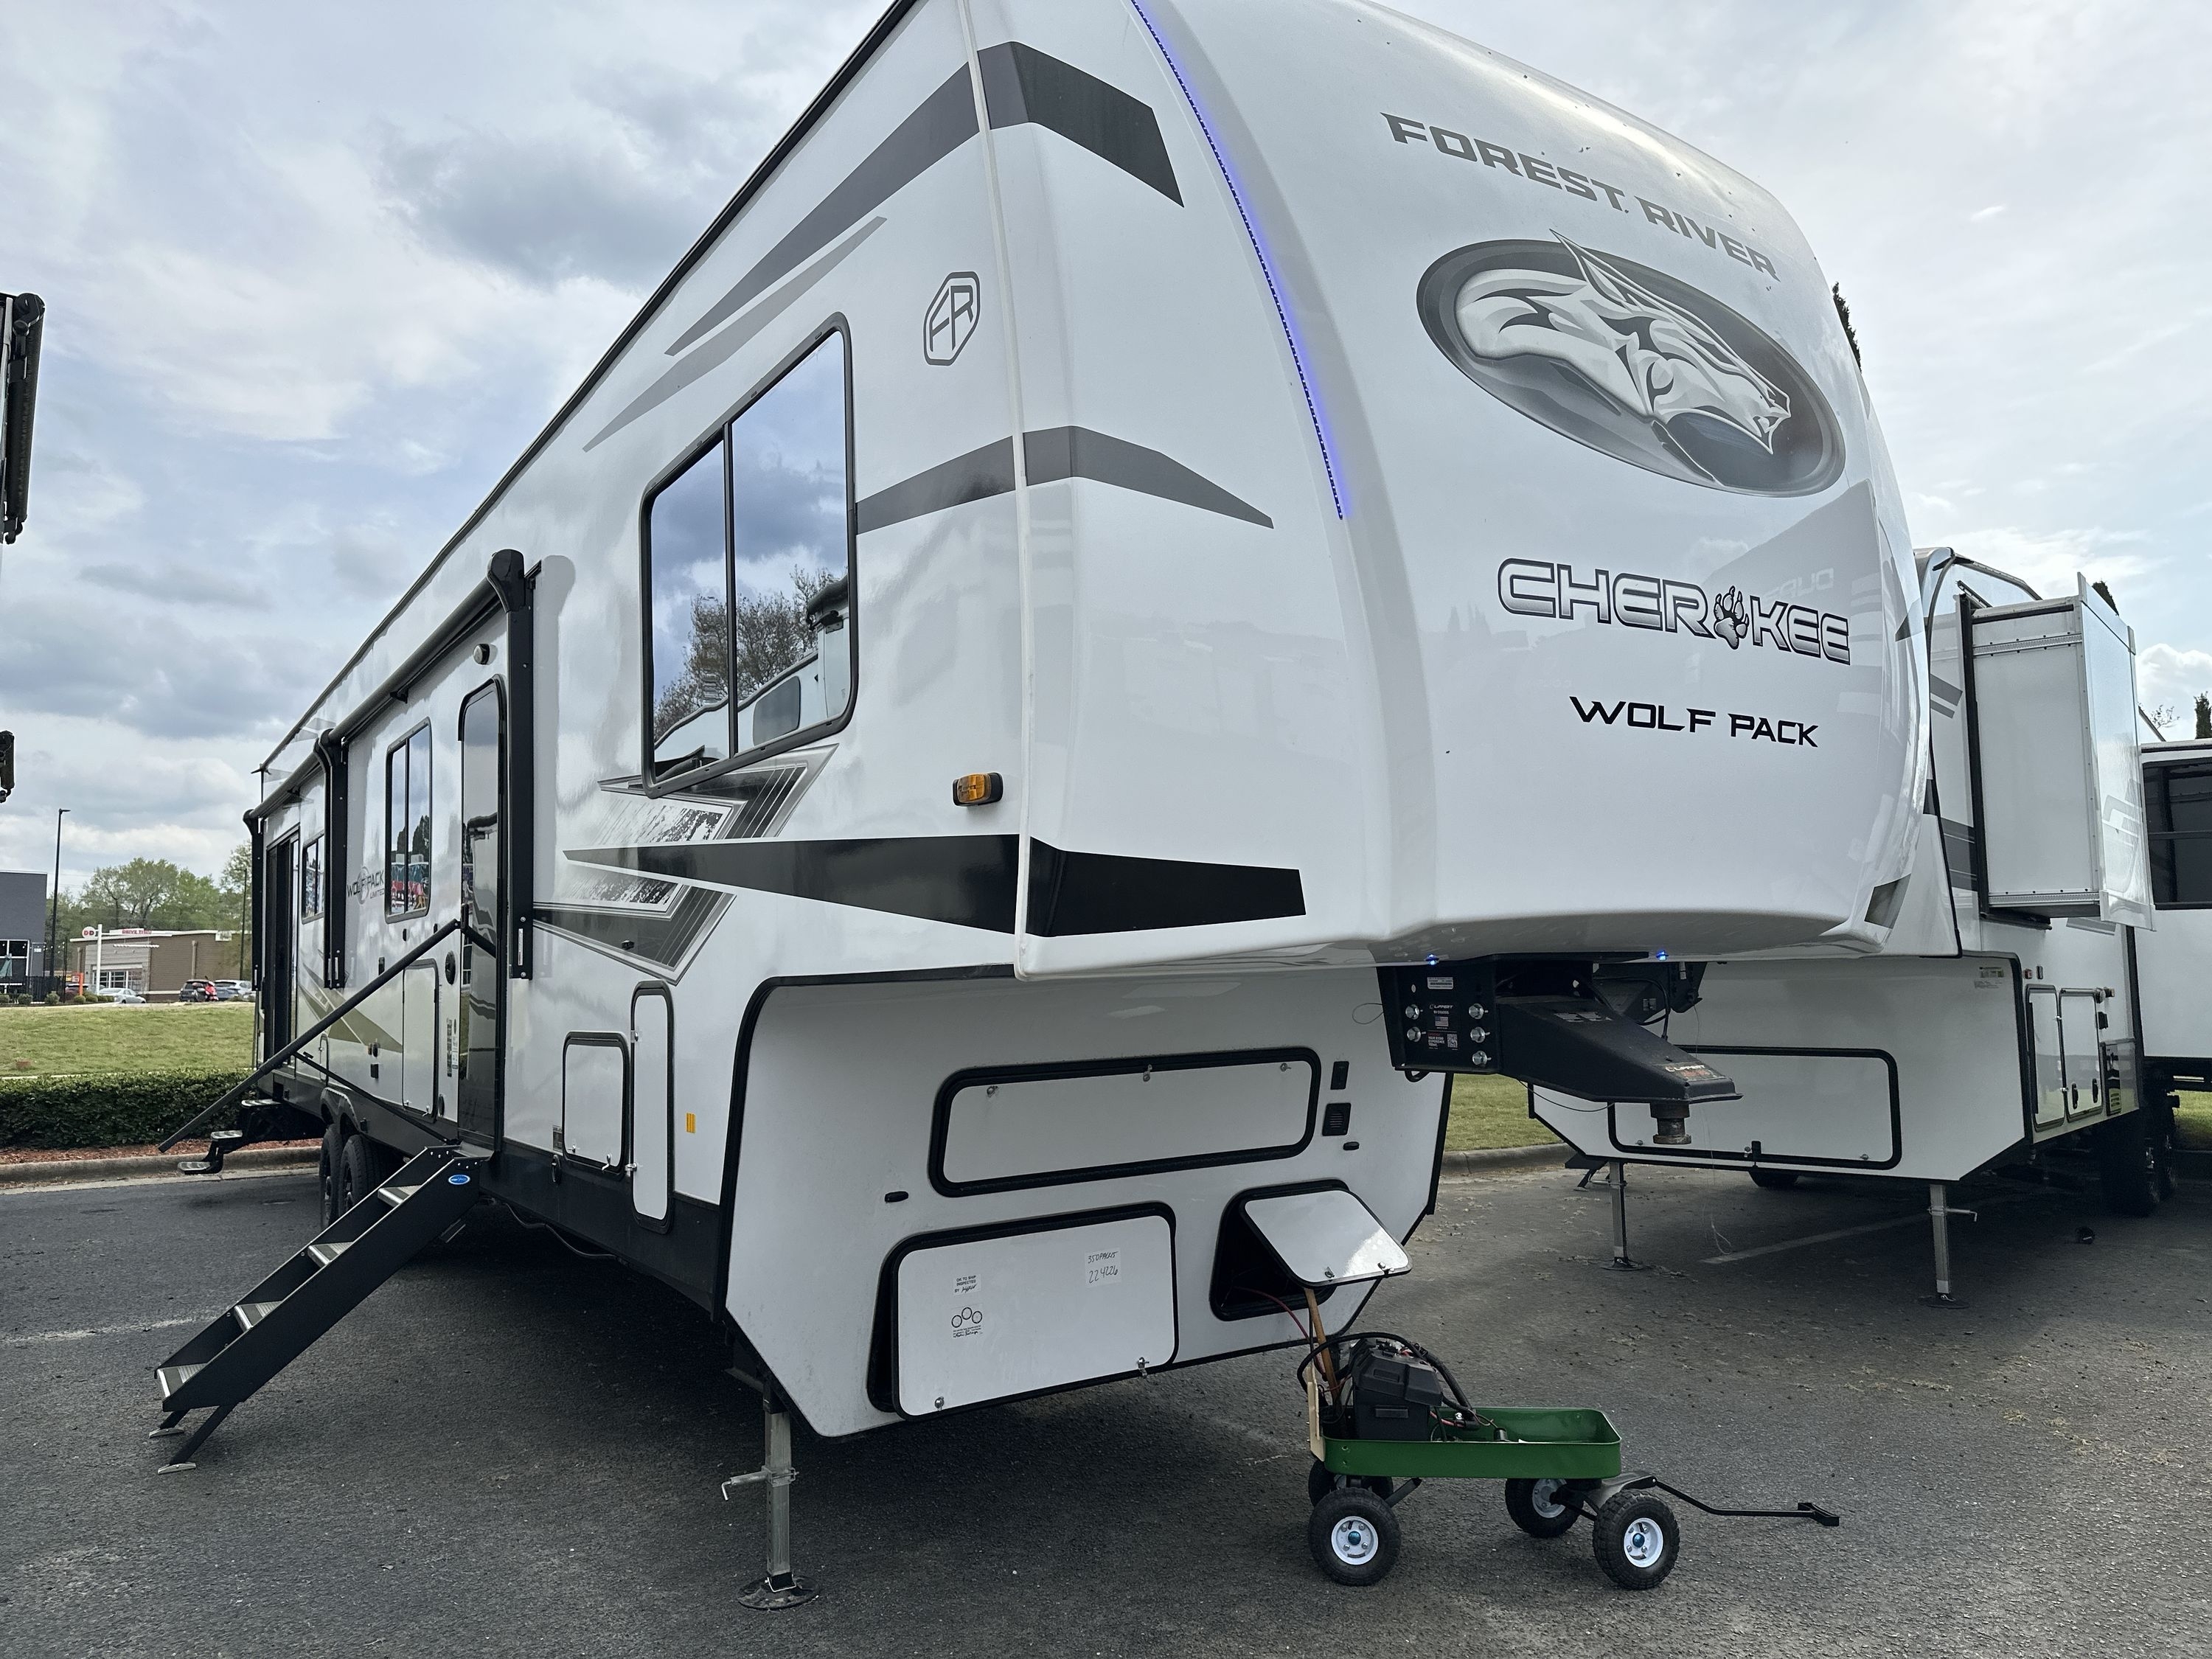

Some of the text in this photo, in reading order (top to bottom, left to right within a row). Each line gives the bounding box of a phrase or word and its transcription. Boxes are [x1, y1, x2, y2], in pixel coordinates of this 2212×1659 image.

[1380, 112, 1781, 283] FOREST RIVER
[1497, 557, 1851, 666] CHEROKEE
[1569, 695, 1819, 748] WOLF PACK
[347, 870, 384, 897] WOLF PACK
